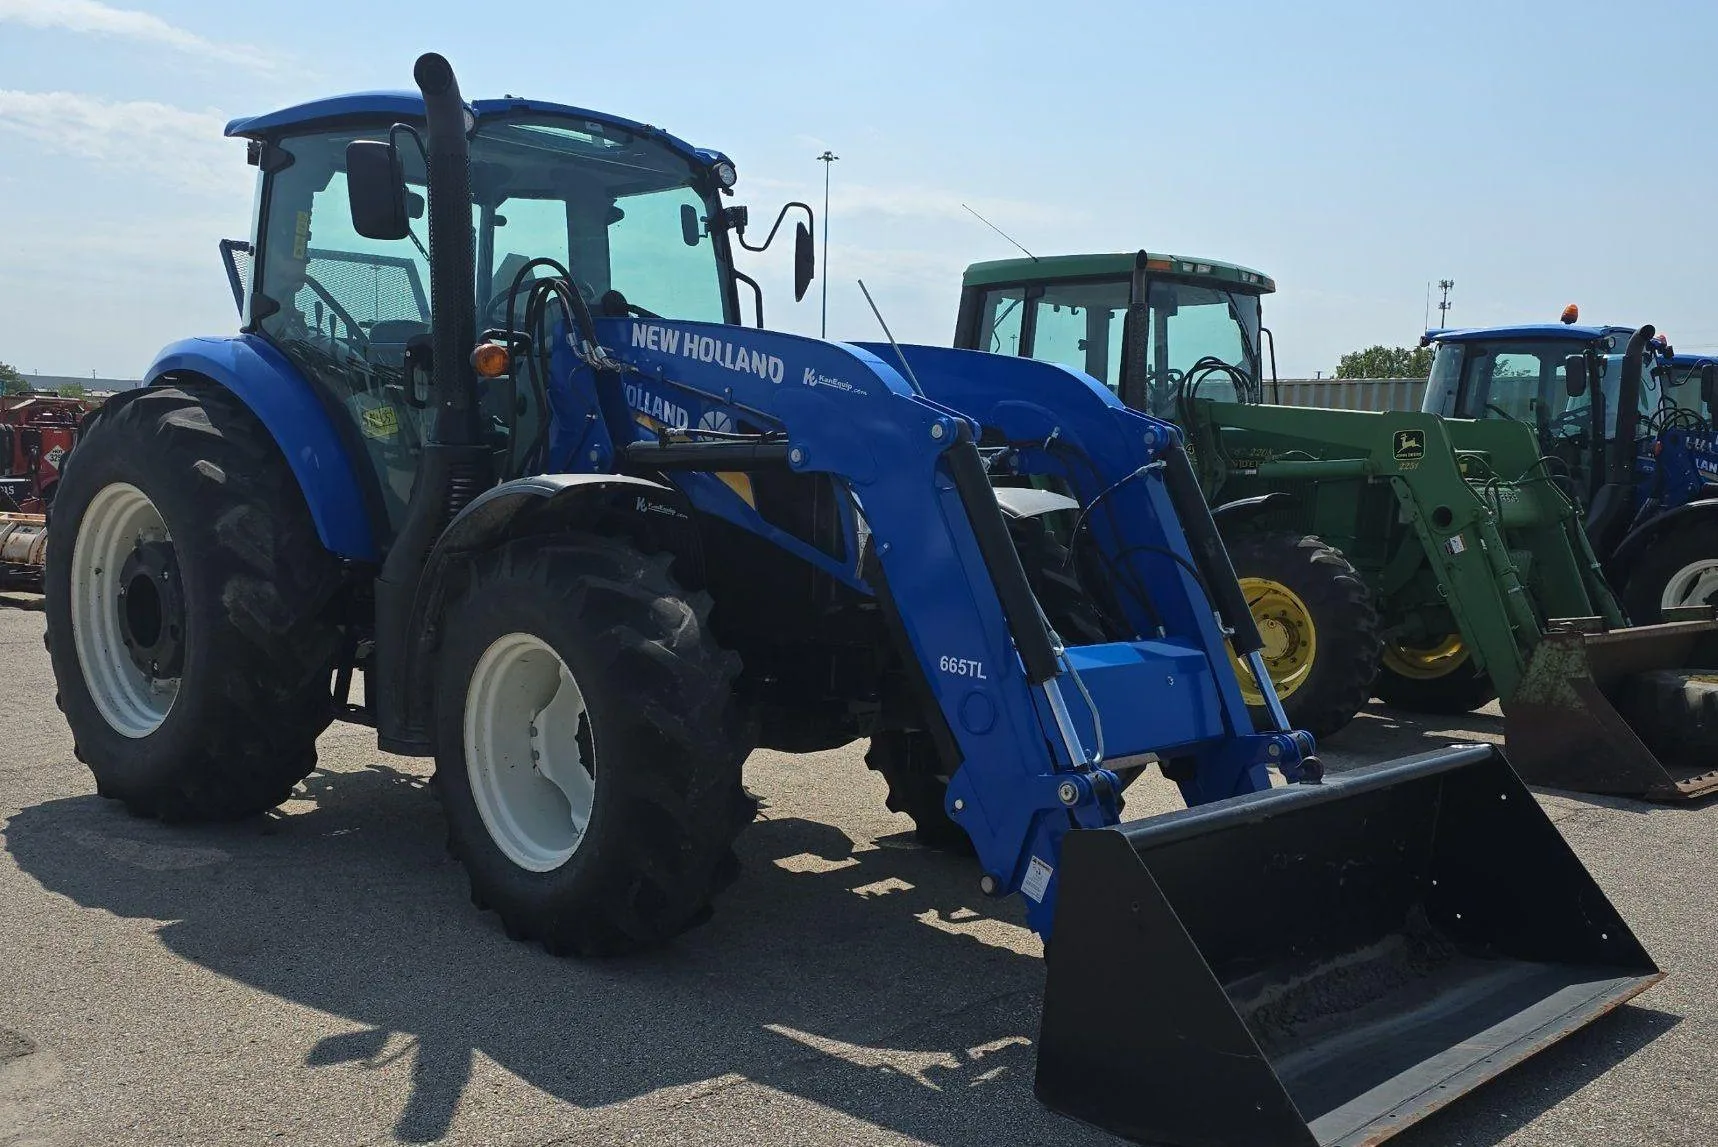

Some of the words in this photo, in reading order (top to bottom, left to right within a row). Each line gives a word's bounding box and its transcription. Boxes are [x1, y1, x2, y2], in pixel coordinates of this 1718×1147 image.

[631, 322, 680, 355] NEW
[683, 332, 785, 384] HOLLAND
[623, 382, 689, 431] OLLAND
[939, 655, 987, 680] 665TL
